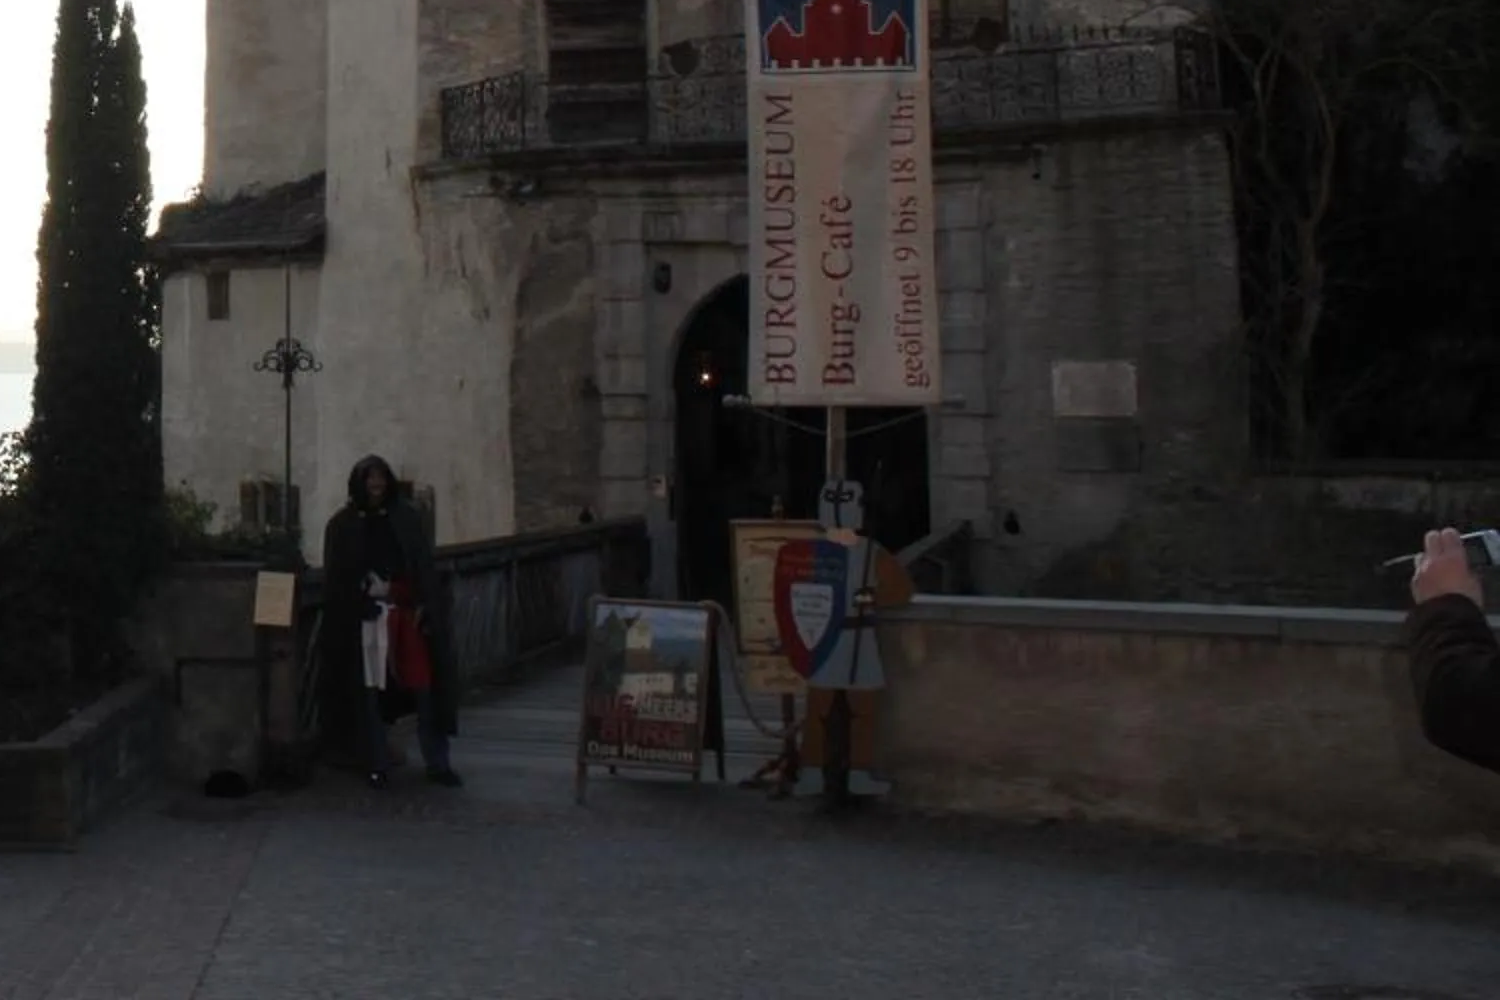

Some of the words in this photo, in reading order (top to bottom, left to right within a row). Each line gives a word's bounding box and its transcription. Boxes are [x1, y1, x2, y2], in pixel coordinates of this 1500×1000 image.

[889, 88, 916, 147] Uhr
[890, 157, 917, 183] 18
[765, 93, 796, 384] BURGMUSEUM
[891, 195, 918, 235] bis
[894, 247, 919, 262] 9
[820, 195, 860, 386] Burg-Café
[894, 274, 930, 388] geöffnet
